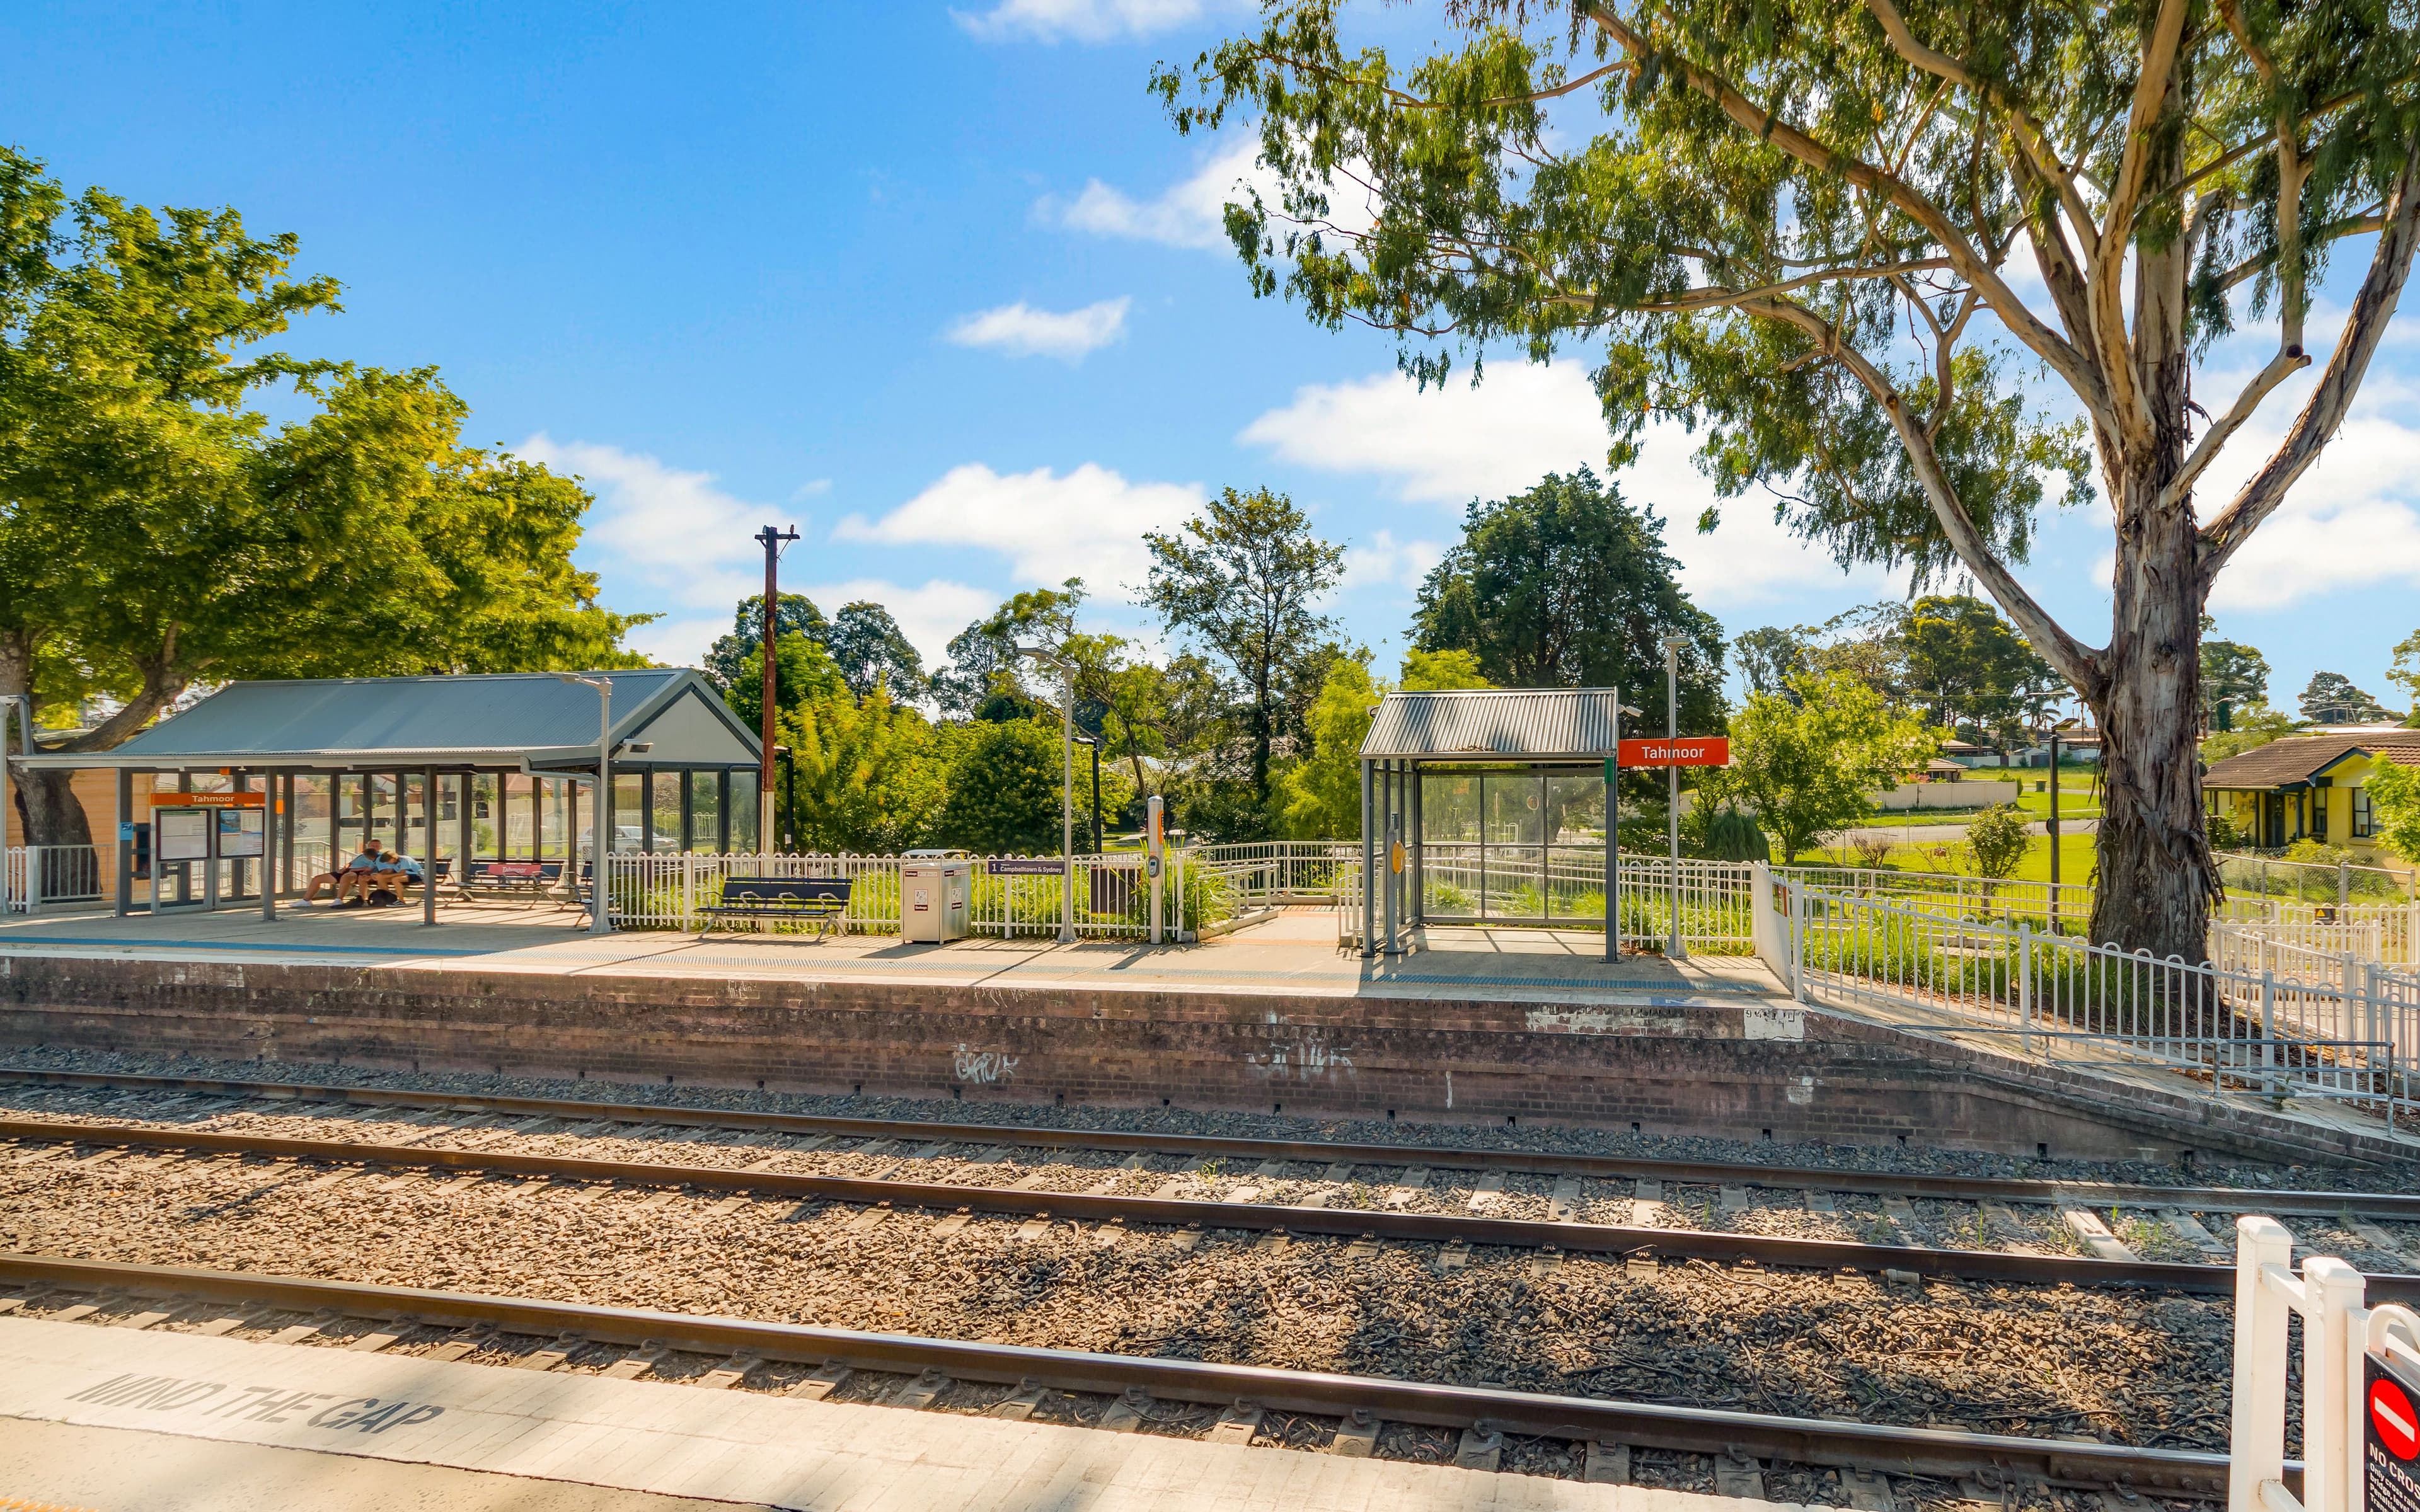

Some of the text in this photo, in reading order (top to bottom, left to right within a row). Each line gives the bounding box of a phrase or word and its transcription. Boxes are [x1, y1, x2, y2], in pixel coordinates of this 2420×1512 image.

[1641, 746, 1705, 759] Tahmoor
[992, 863, 997, 872] 1
[64, 1373, 446, 1433] MIND THE GAP
[2370, 1442, 2387, 1467] NO
[2370, 1462, 2385, 1482] Only
[2385, 1478, 2403, 1498] cross
[2370, 1472, 2393, 1500] bridge,
